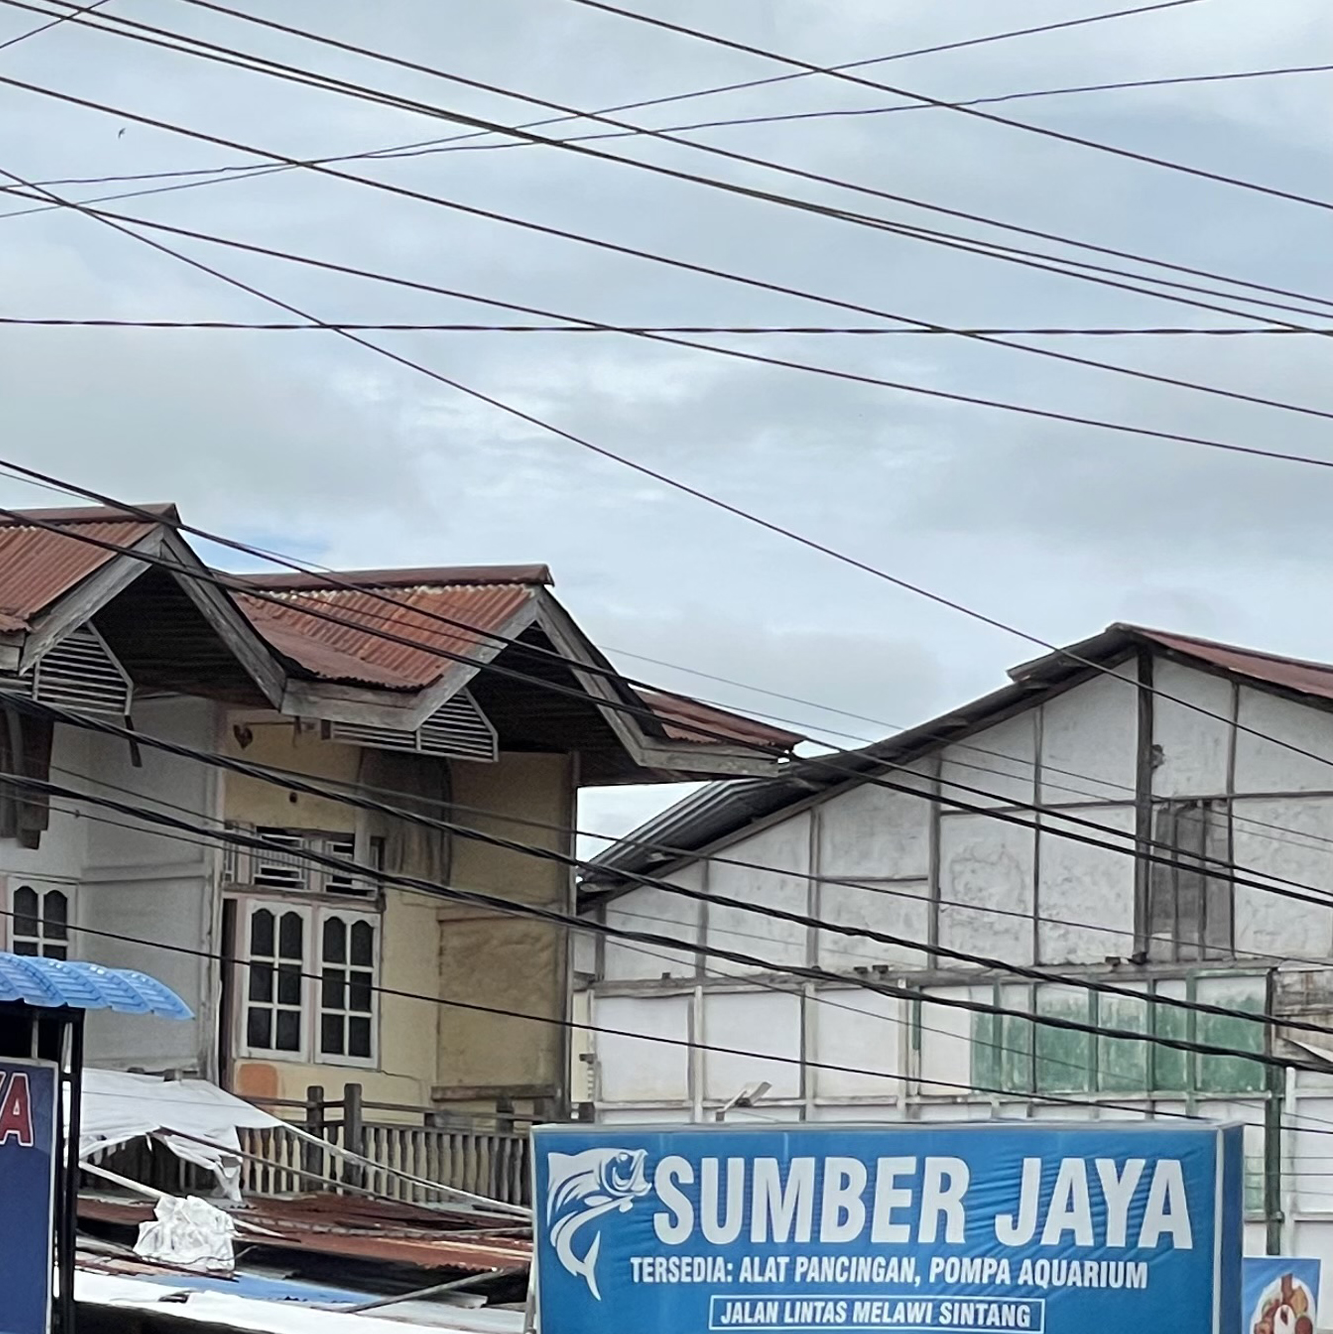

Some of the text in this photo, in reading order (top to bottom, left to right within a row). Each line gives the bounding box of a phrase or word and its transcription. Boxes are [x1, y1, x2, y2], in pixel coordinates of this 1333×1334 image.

[653, 1155, 1194, 1249] SUMBER JAYA
[630, 1257, 1148, 1289] TERSEDIA: ALAT PANCINGAN, POMPA AQUARIUM
[720, 1302, 1031, 1328] JALAN LINTAS MELAWI SINTANG
